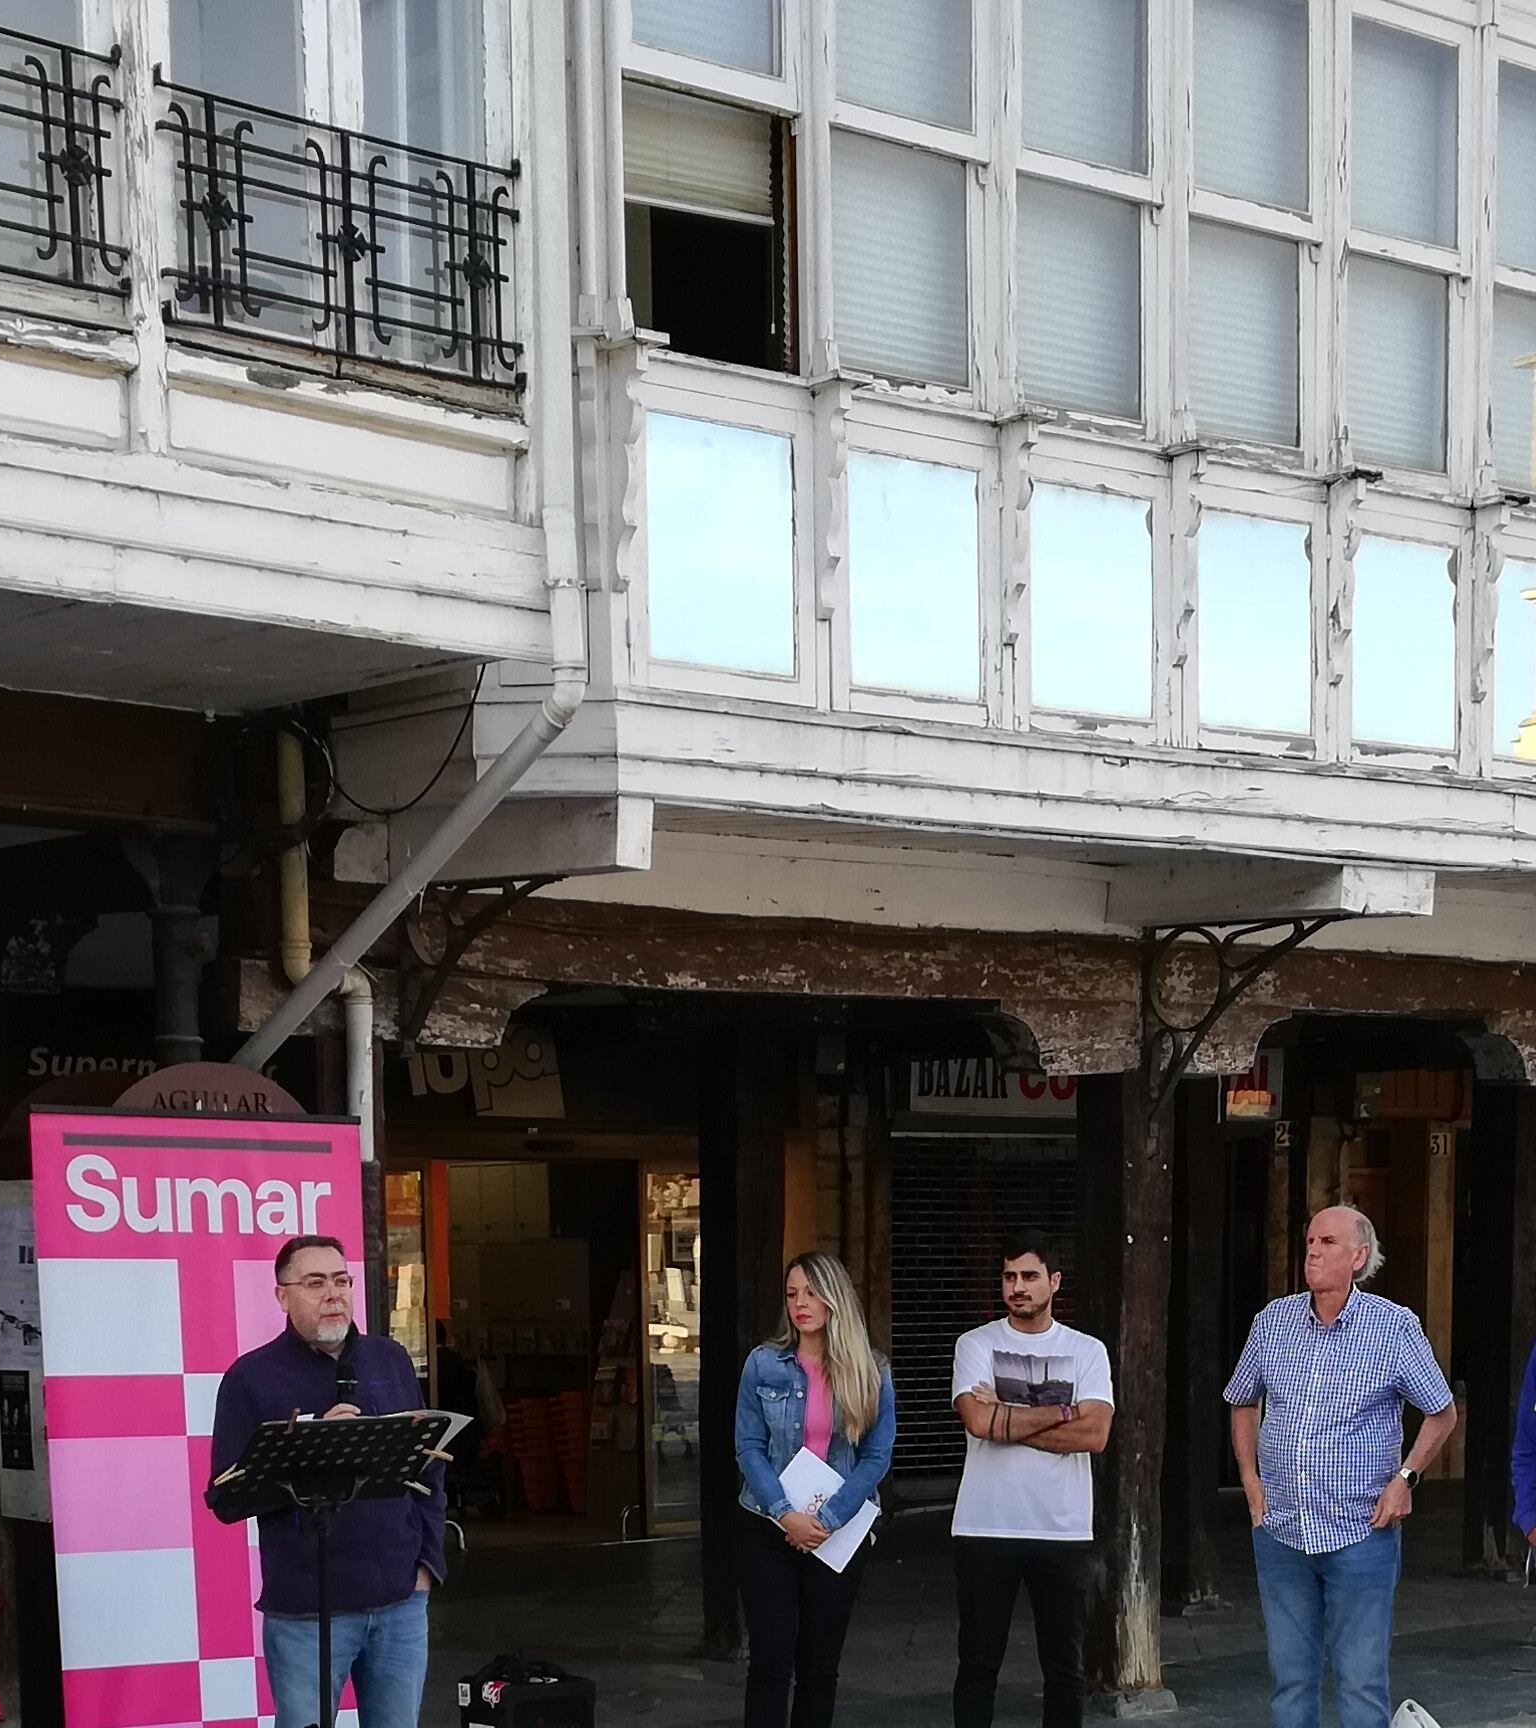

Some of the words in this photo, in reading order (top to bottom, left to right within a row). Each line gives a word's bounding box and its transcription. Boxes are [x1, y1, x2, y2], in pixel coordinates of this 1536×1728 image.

[917, 1057, 1008, 1099] BAZAR
[1430, 1134, 1447, 1156] 31
[65, 1153, 333, 1236] Sumar
